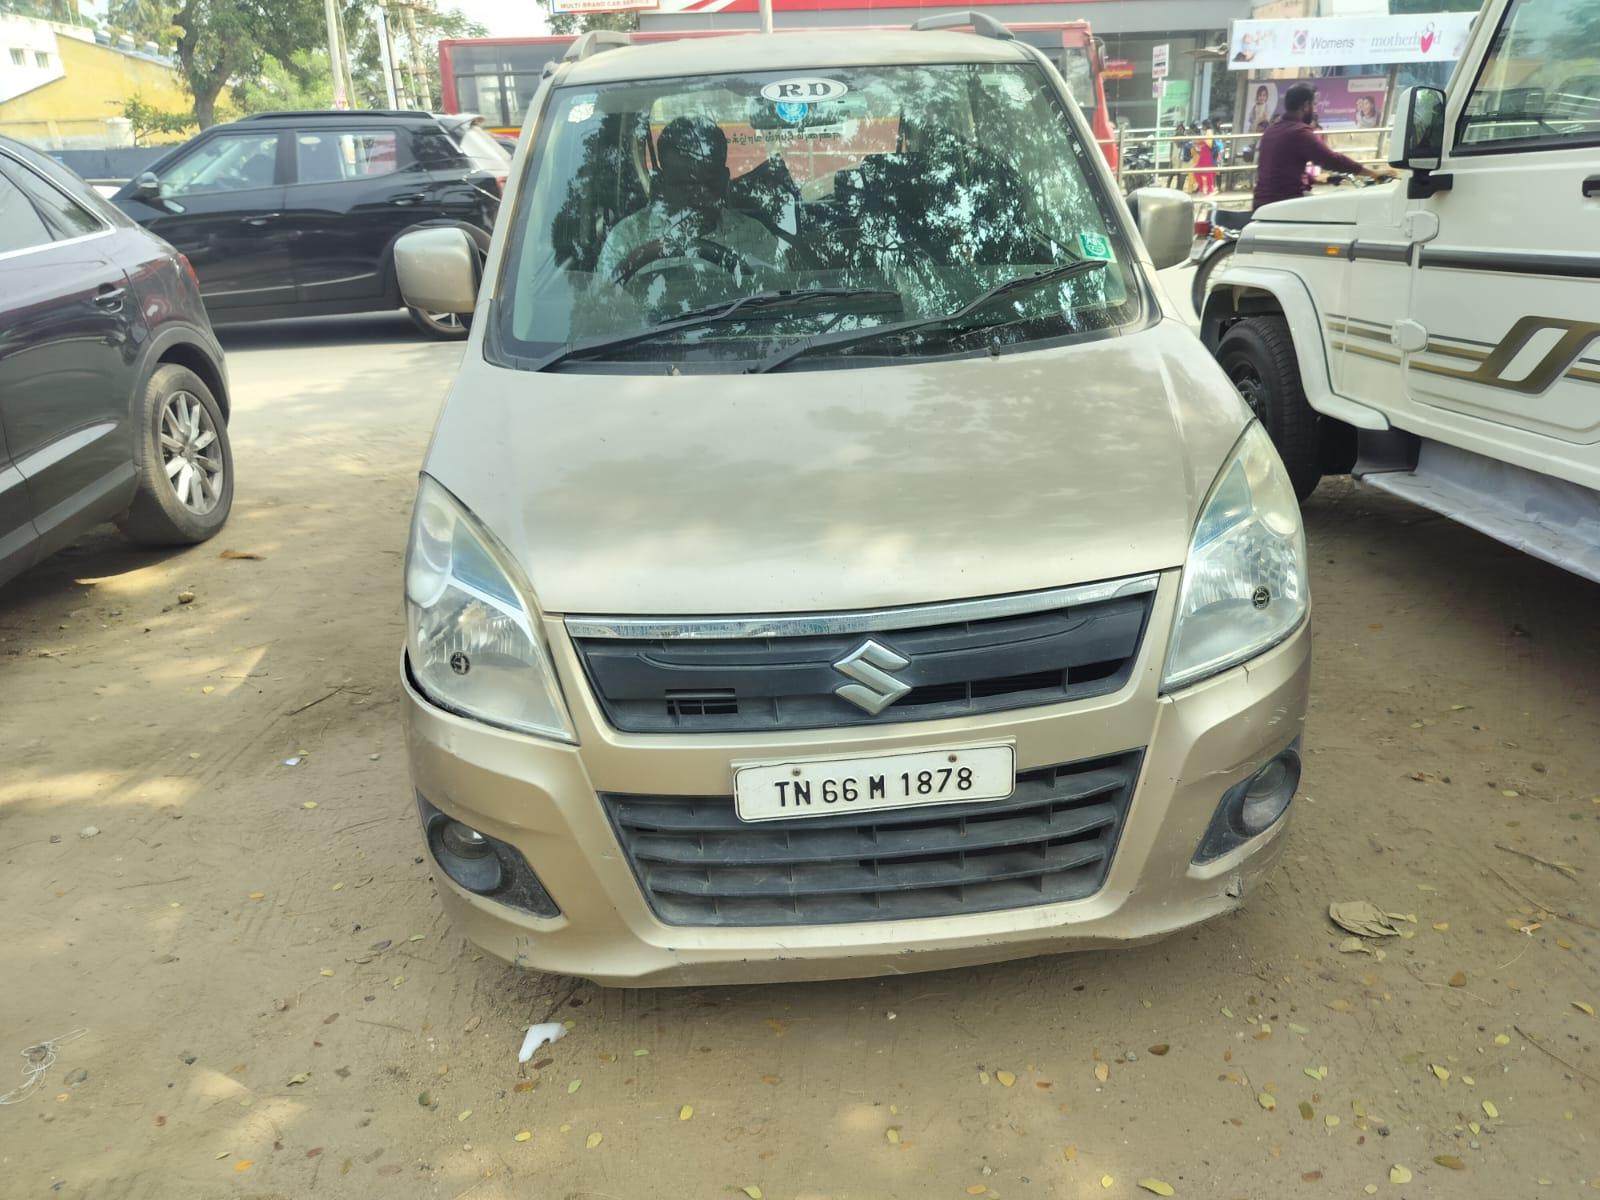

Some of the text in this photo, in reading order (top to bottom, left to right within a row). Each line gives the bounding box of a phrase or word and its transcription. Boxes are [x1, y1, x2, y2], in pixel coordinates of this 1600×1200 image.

[1310, 36, 1355, 50] Womens
[774, 767, 973, 807] TN 66 M 1878
